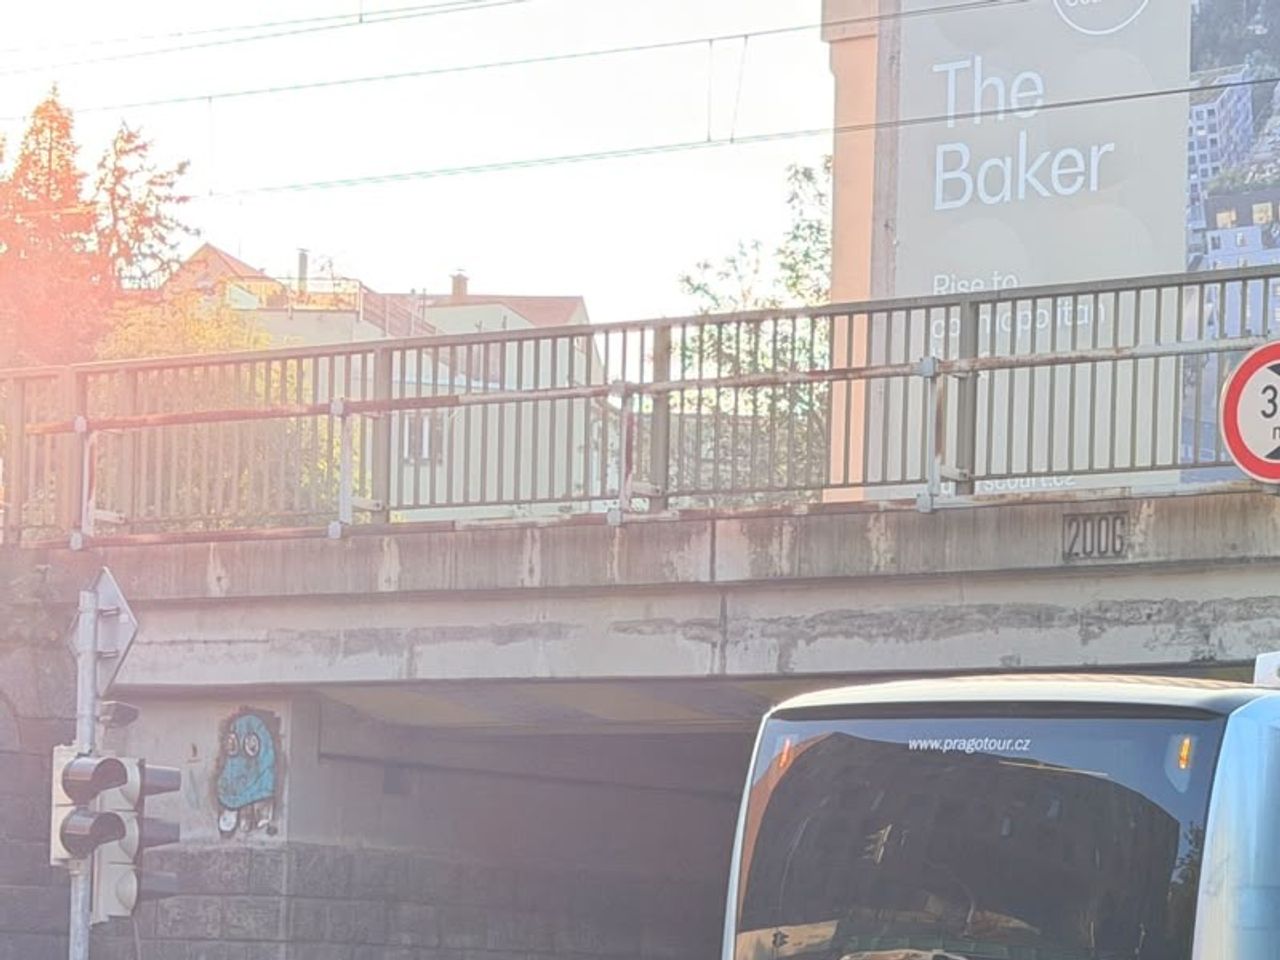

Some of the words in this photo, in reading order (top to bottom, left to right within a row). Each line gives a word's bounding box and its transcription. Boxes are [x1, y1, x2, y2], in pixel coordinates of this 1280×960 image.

[932, 55, 1043, 128] The
[934, 129, 1115, 210] Baker
[1067, 516, 1126, 556] 2006
[908, 736, 1033, 754] www.pragotour.cz
